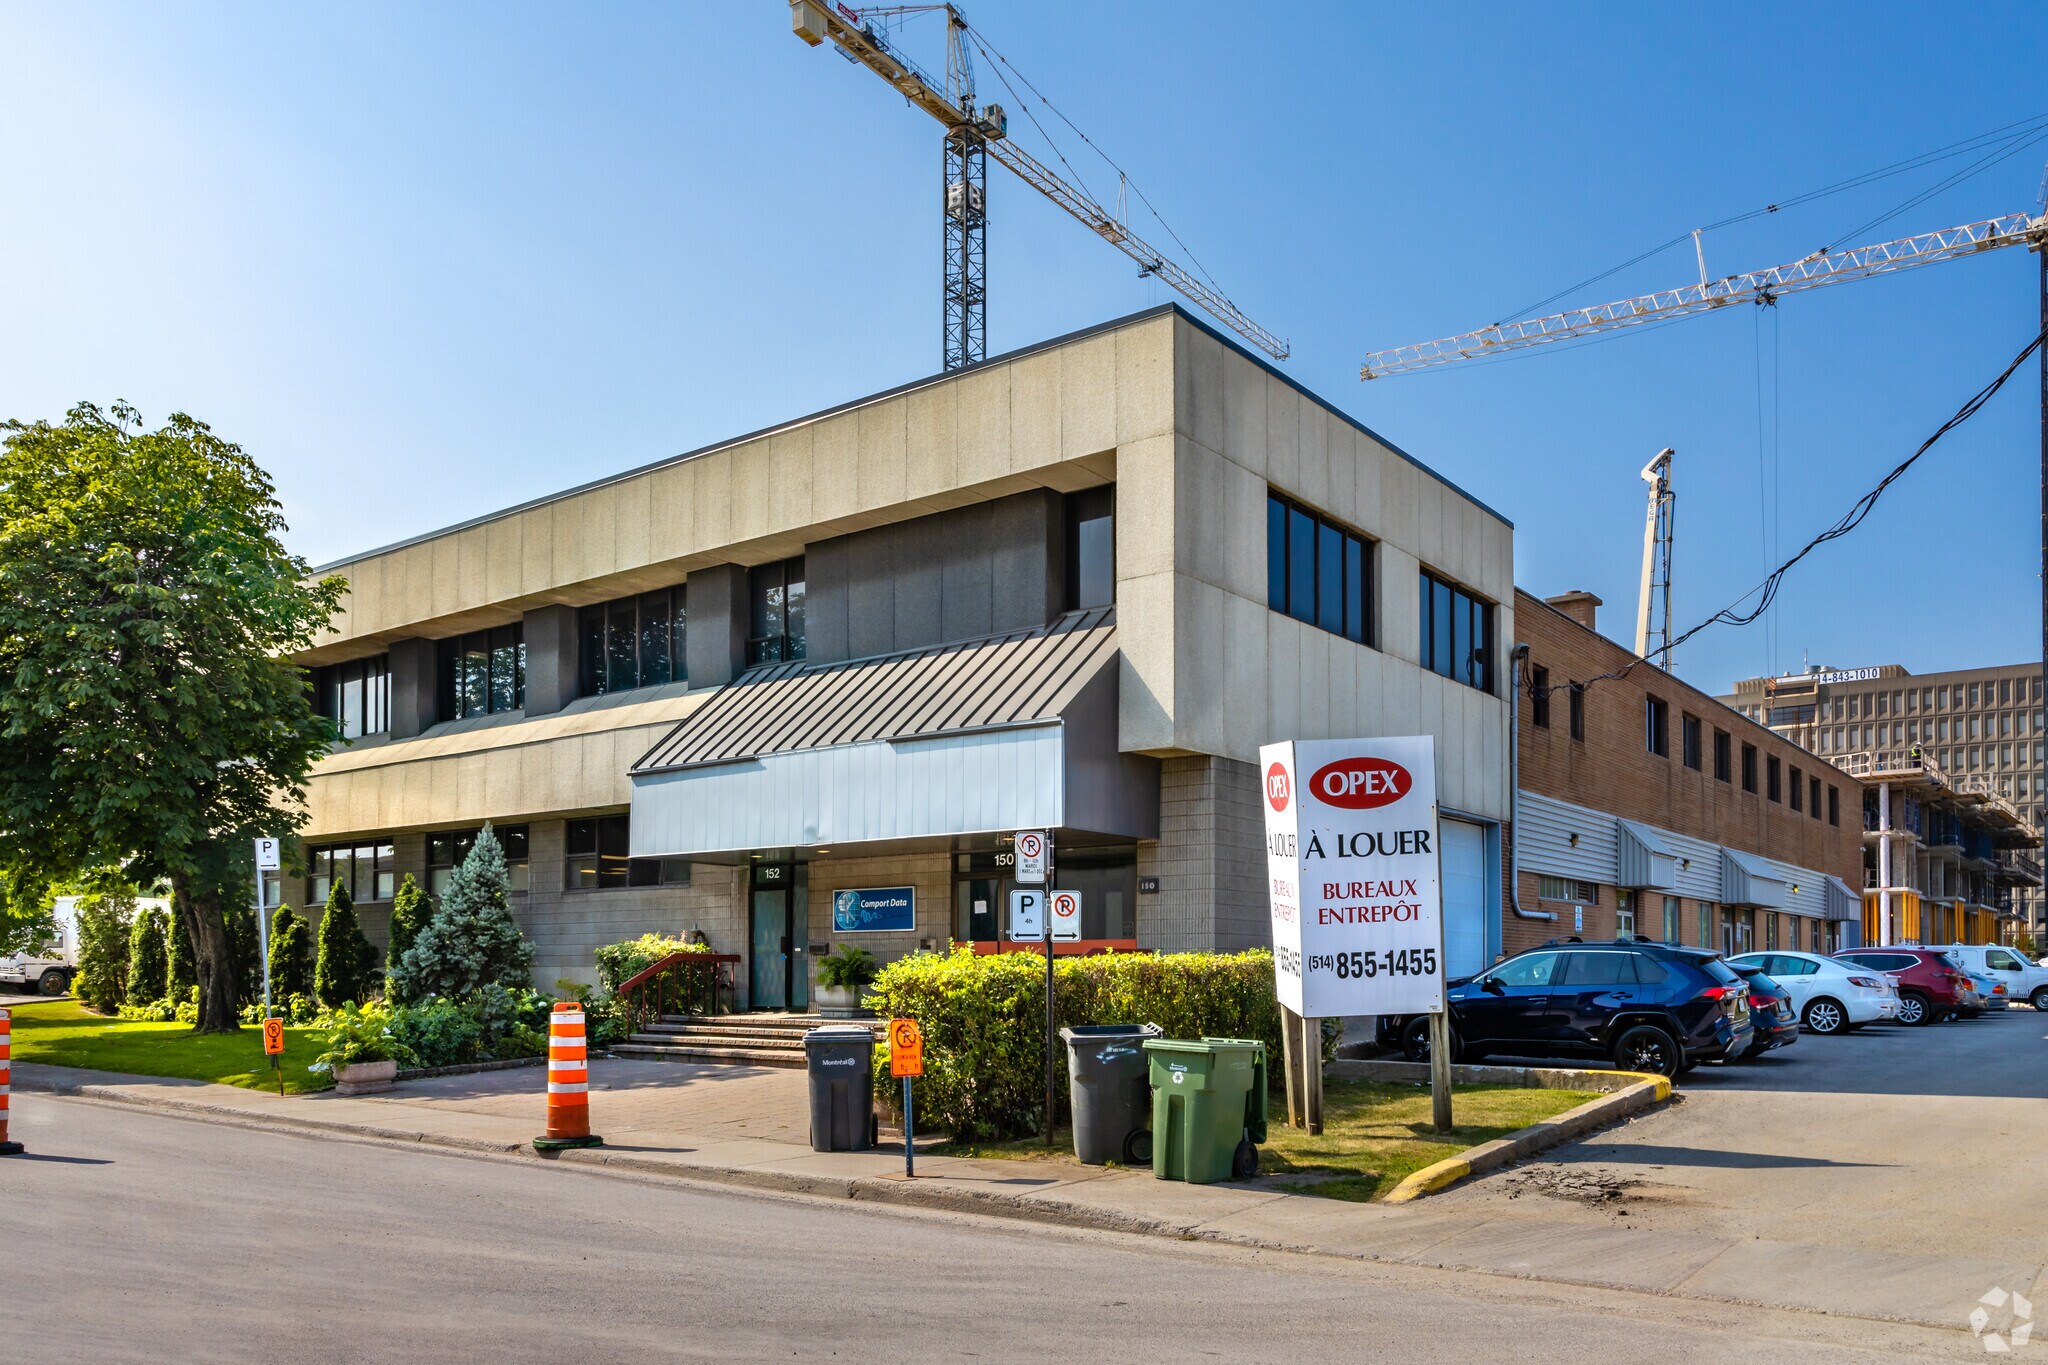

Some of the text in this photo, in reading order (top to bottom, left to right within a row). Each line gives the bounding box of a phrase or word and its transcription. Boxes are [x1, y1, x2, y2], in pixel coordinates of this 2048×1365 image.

[1269, 774, 1289, 798] OPEX
[1323, 770, 1400, 797] OPEX
[263, 841, 272, 853] P
[1275, 833, 1297, 858] LOUER
[1305, 829, 1432, 860] À LOUER
[994, 853, 1014, 867] 150
[765, 868, 780, 879] 152
[1141, 882, 1155, 890] 150
[1323, 879, 1417, 900] BUREAUX
[860, 898, 908, 909] Comport Data
[1021, 895, 1035, 914] P
[1319, 900, 1422, 925] ENTREPÔT
[1308, 948, 1437, 979] (514) 855-1455
